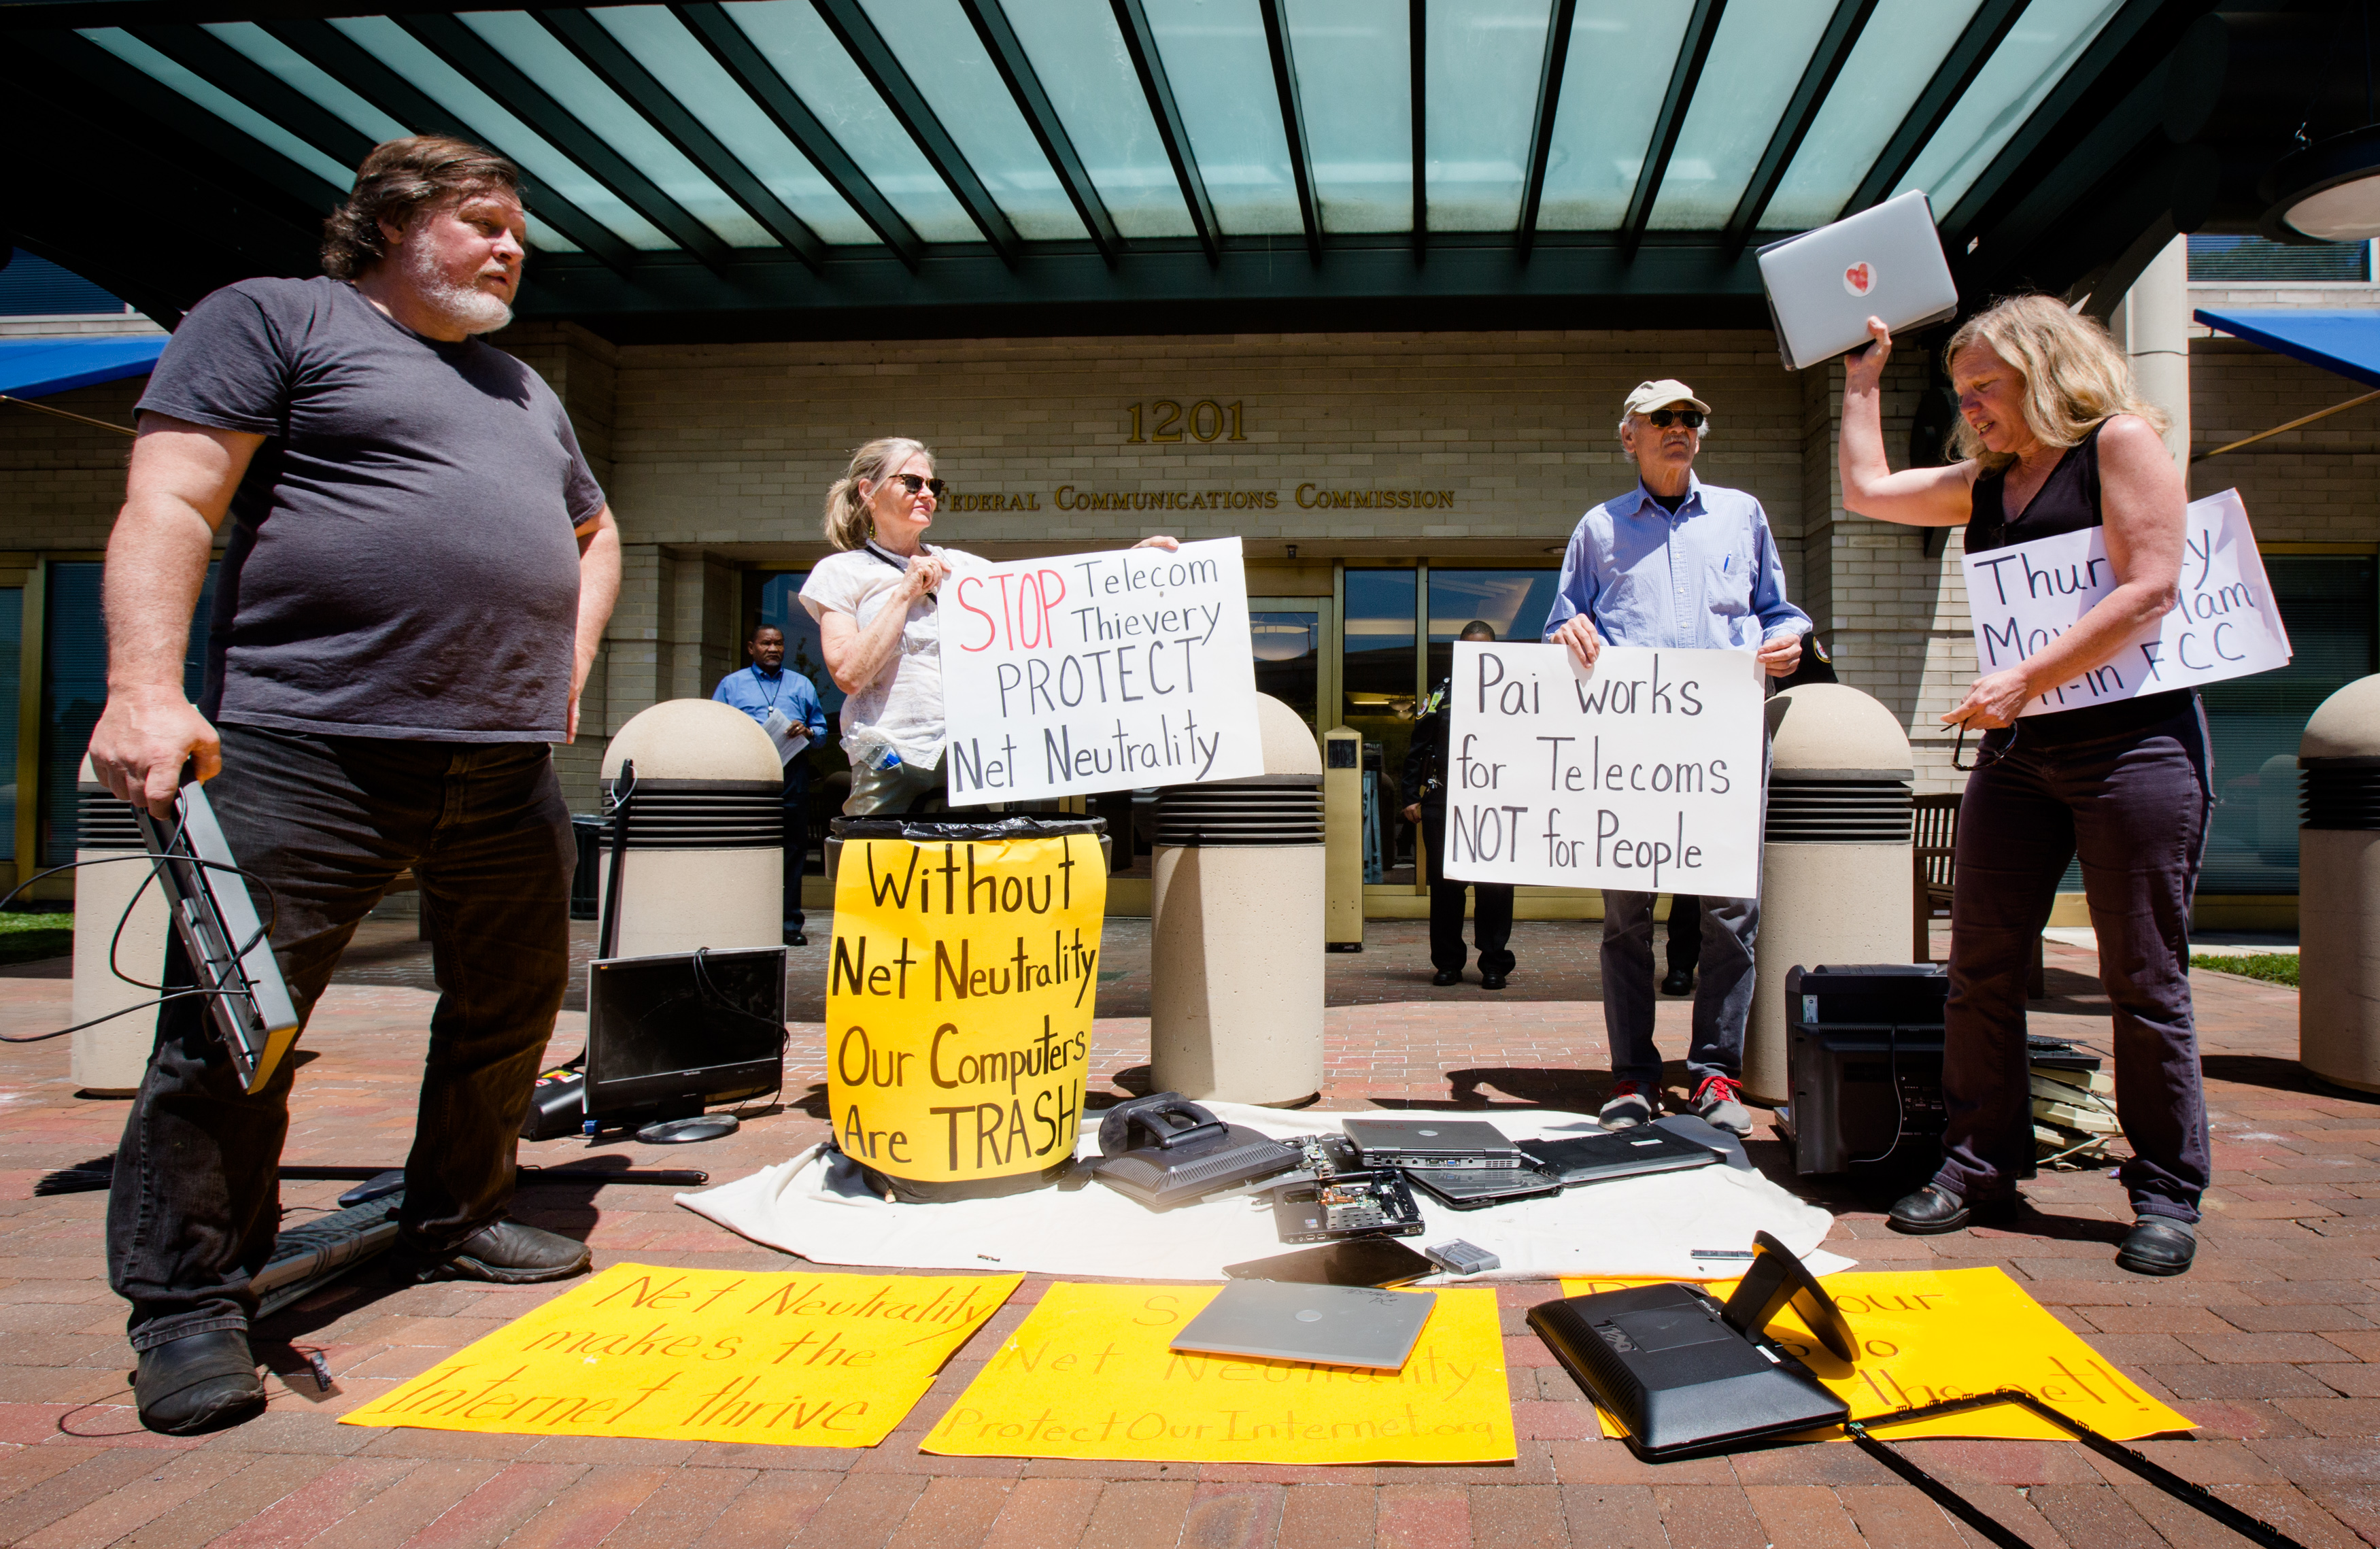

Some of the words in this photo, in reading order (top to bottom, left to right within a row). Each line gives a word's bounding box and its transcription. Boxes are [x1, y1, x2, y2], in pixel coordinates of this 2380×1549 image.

[1127, 400, 1247, 442] 1201
[1055, 485, 1278, 510] COMMUNICATIONS
[1295, 483, 1455, 509] COMMISSION
[1974, 530, 2209, 605] Thury
[957, 569, 1066, 651] STOP
[1074, 558, 1218, 597] Telecom
[1072, 602, 1221, 645] Thievery
[998, 636, 1202, 717] PROTECT
[1479, 653, 1539, 715] Pai
[1575, 653, 1703, 715] works
[2140, 622, 2246, 681] FCC
[953, 734, 1017, 792] Net
[1044, 709, 1219, 781] Neutrality
[1457, 734, 1506, 788] for
[1536, 736, 1730, 794] Telecoms
[867, 836, 1075, 915] Without
[1452, 805, 1528, 863] NOT
[1543, 808, 1584, 868] for
[1597, 810, 1702, 887] People
[832, 936, 917, 999] Net
[935, 927, 1096, 1008] Neutrality
[838, 1025, 915, 1087] Our
[930, 1015, 1085, 1095] Computers
[845, 1104, 913, 1163] Are
[930, 1078, 1077, 1172] TRASH
[520, 1323, 743, 1361] makes
[770, 1331, 877, 1367] the
[592, 1276, 747, 1313] Net
[745, 1282, 993, 1346] Neutrality
[1593, 1319, 1635, 1353] DELL
[998, 1342, 1125, 1375] Net
[364, 1363, 685, 1426] Internet
[679, 1376, 870, 1431] thrive
